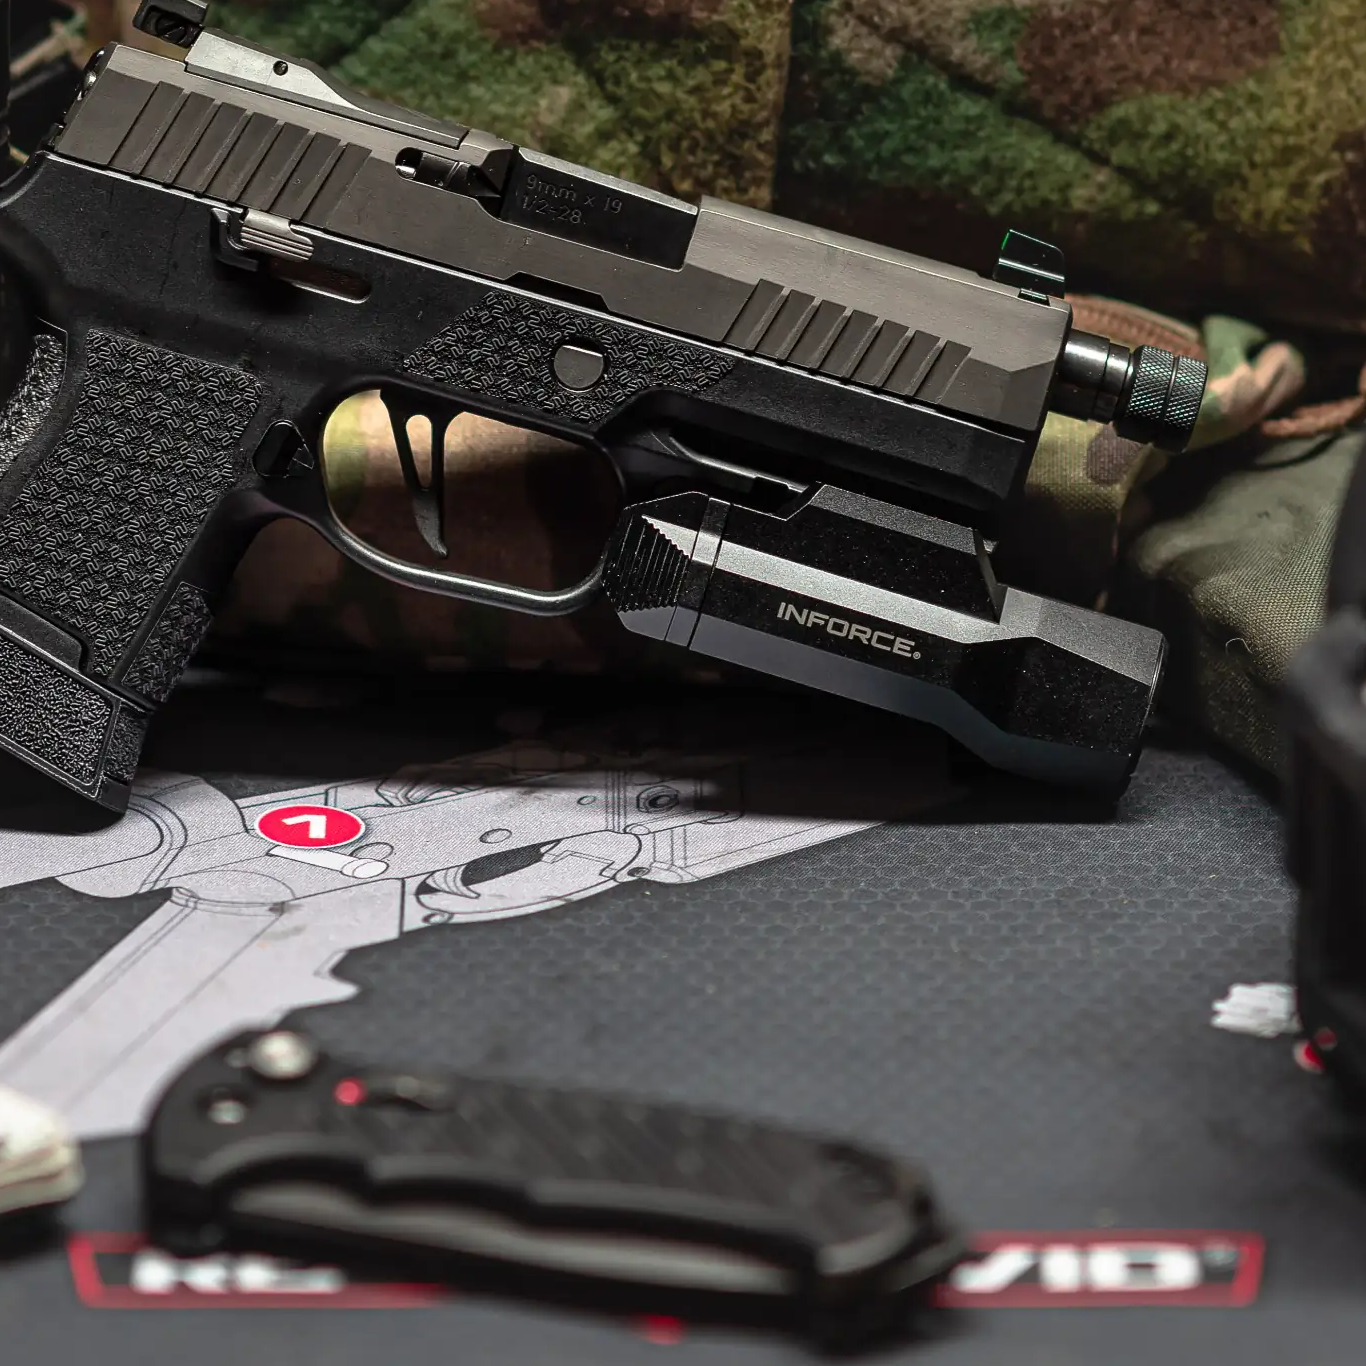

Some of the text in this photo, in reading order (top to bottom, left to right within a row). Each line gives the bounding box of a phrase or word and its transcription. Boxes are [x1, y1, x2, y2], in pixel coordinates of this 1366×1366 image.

[527, 174, 577, 202] 9mm
[604, 196, 623, 214] 19
[777, 601, 916, 658] INFORCE
